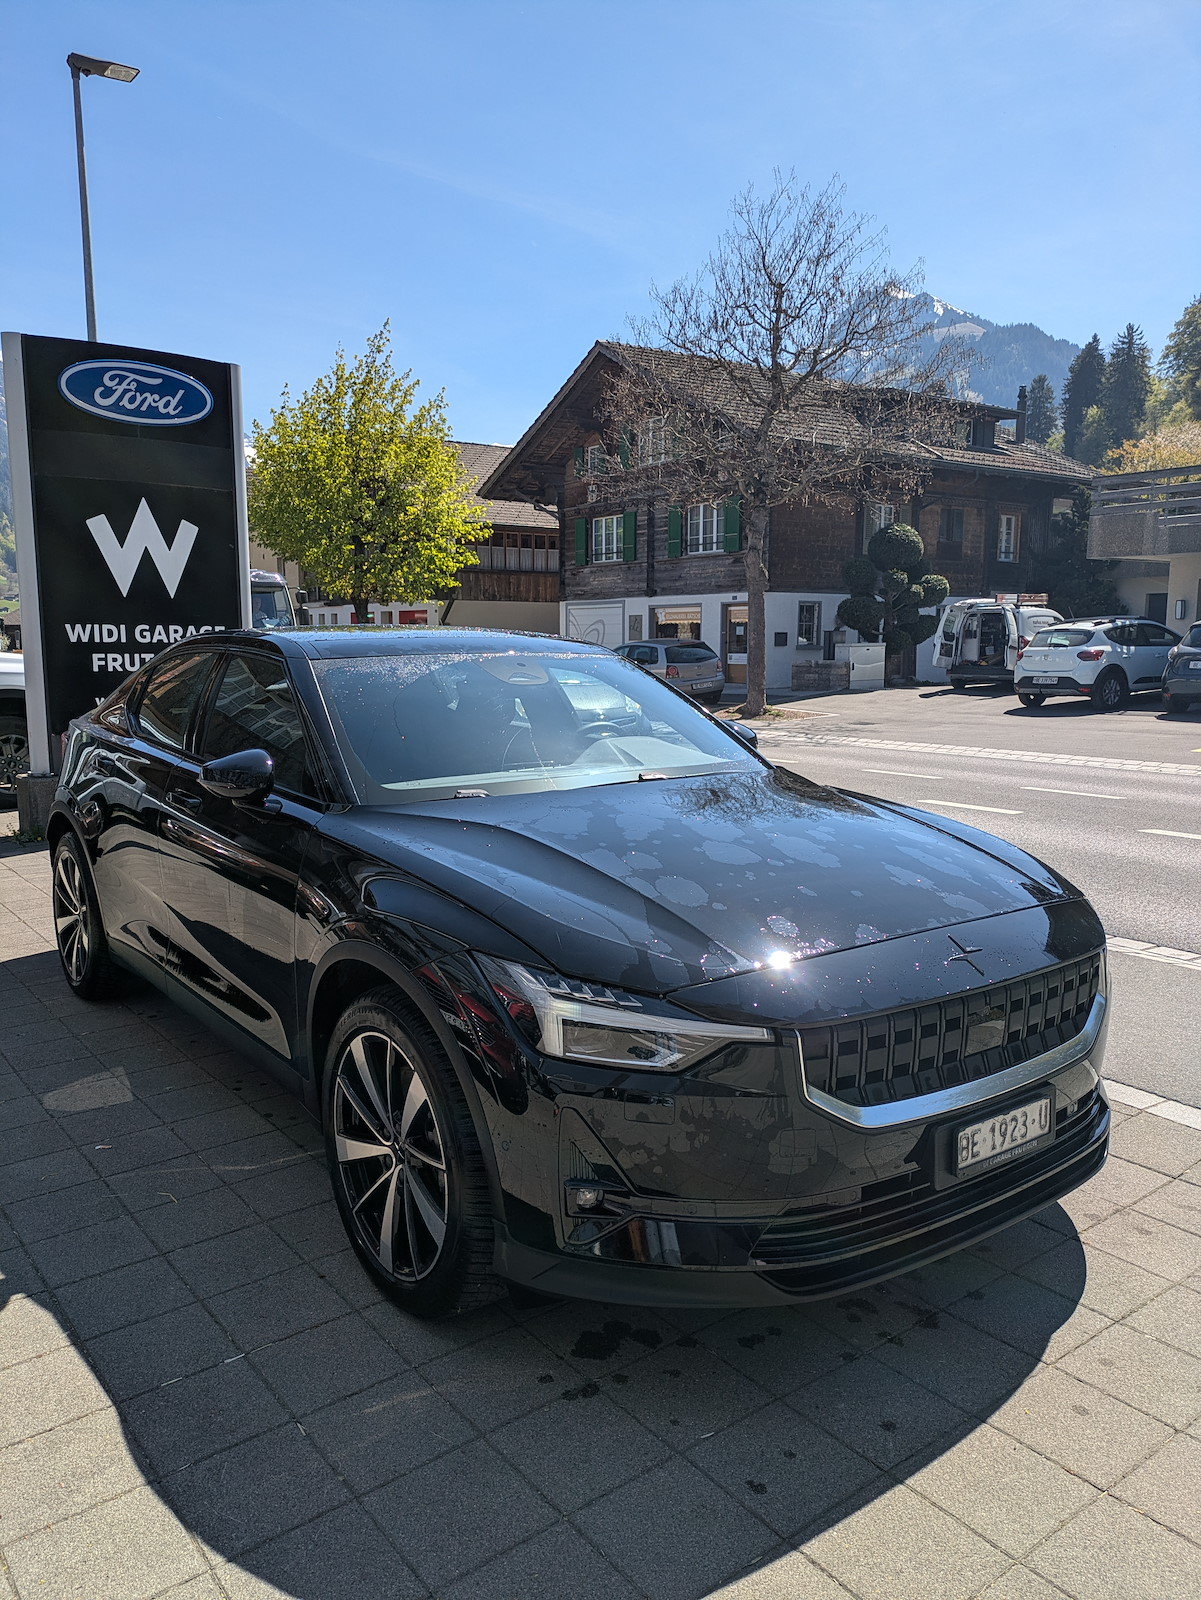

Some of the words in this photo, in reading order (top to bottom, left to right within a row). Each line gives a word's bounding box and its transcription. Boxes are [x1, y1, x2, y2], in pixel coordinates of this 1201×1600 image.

[93, 370, 185, 416] Ford
[86, 497, 199, 599] W
[64, 623, 127, 643] WIDI
[134, 624, 226, 644] GARA
[92, 653, 155, 672] FRUT
[1013, 1140, 1038, 1155] FRUTGEN
